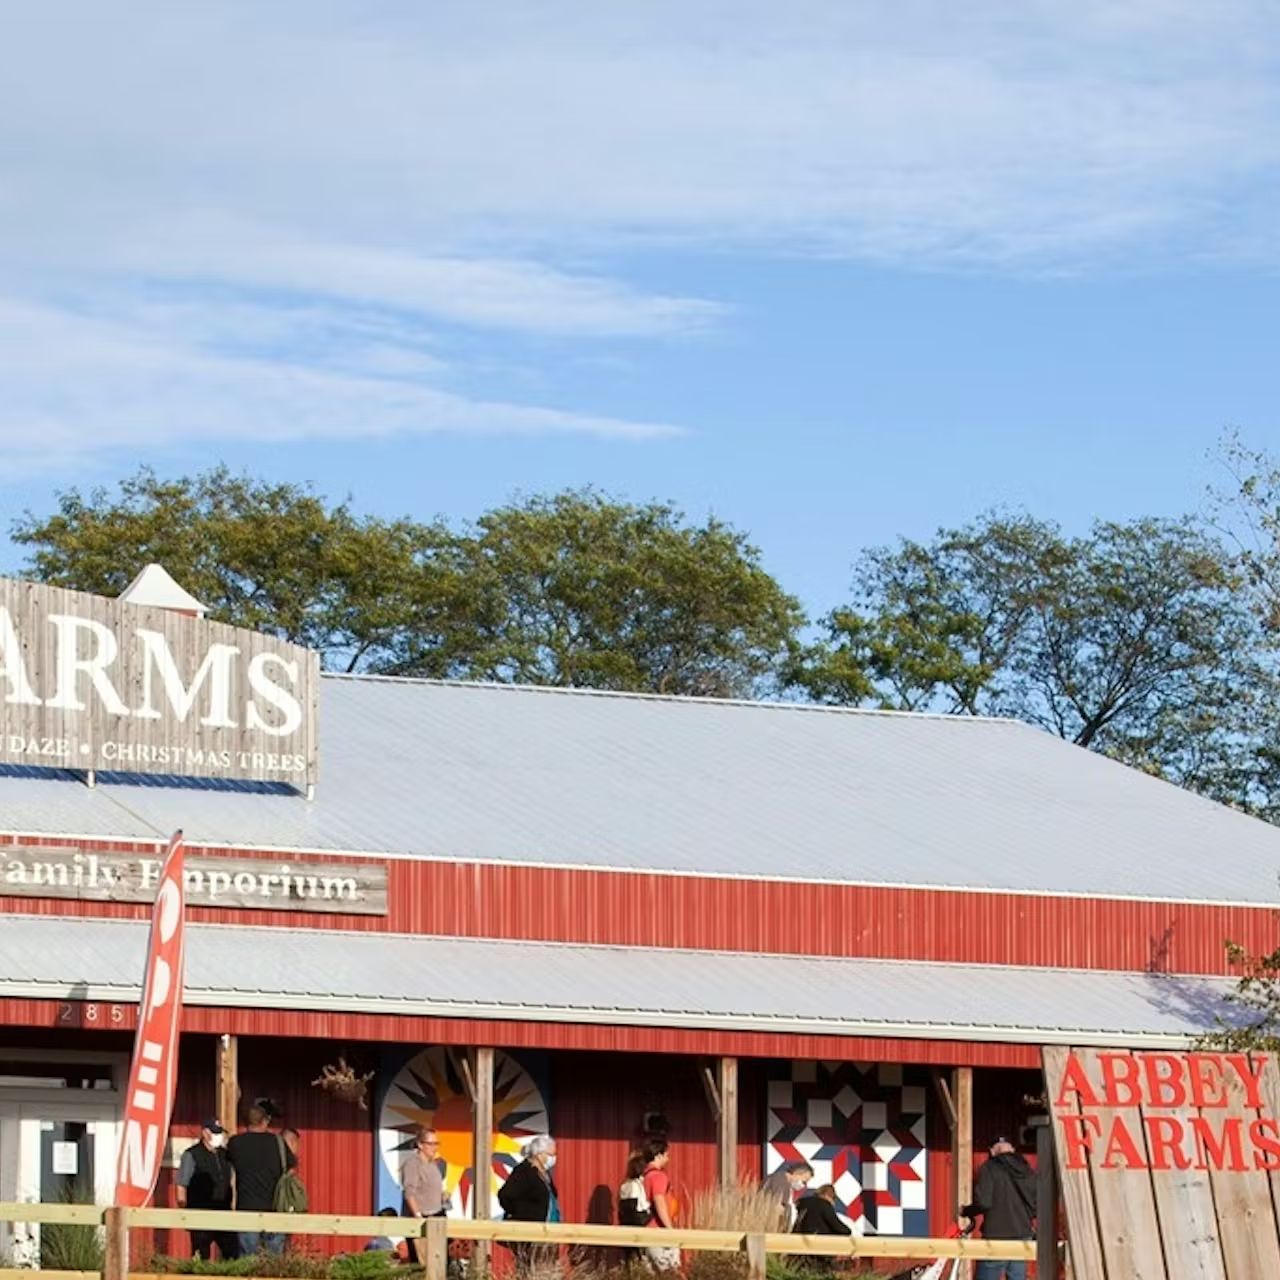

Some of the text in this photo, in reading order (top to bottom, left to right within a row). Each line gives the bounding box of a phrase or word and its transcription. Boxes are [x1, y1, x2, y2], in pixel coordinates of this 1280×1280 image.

[10, 735, 70, 756] DAZE
[100, 741, 230, 768] CHRISTMAS
[236, 750, 306, 772] TREES
[1054, 1052, 1269, 1109] ABBEY
